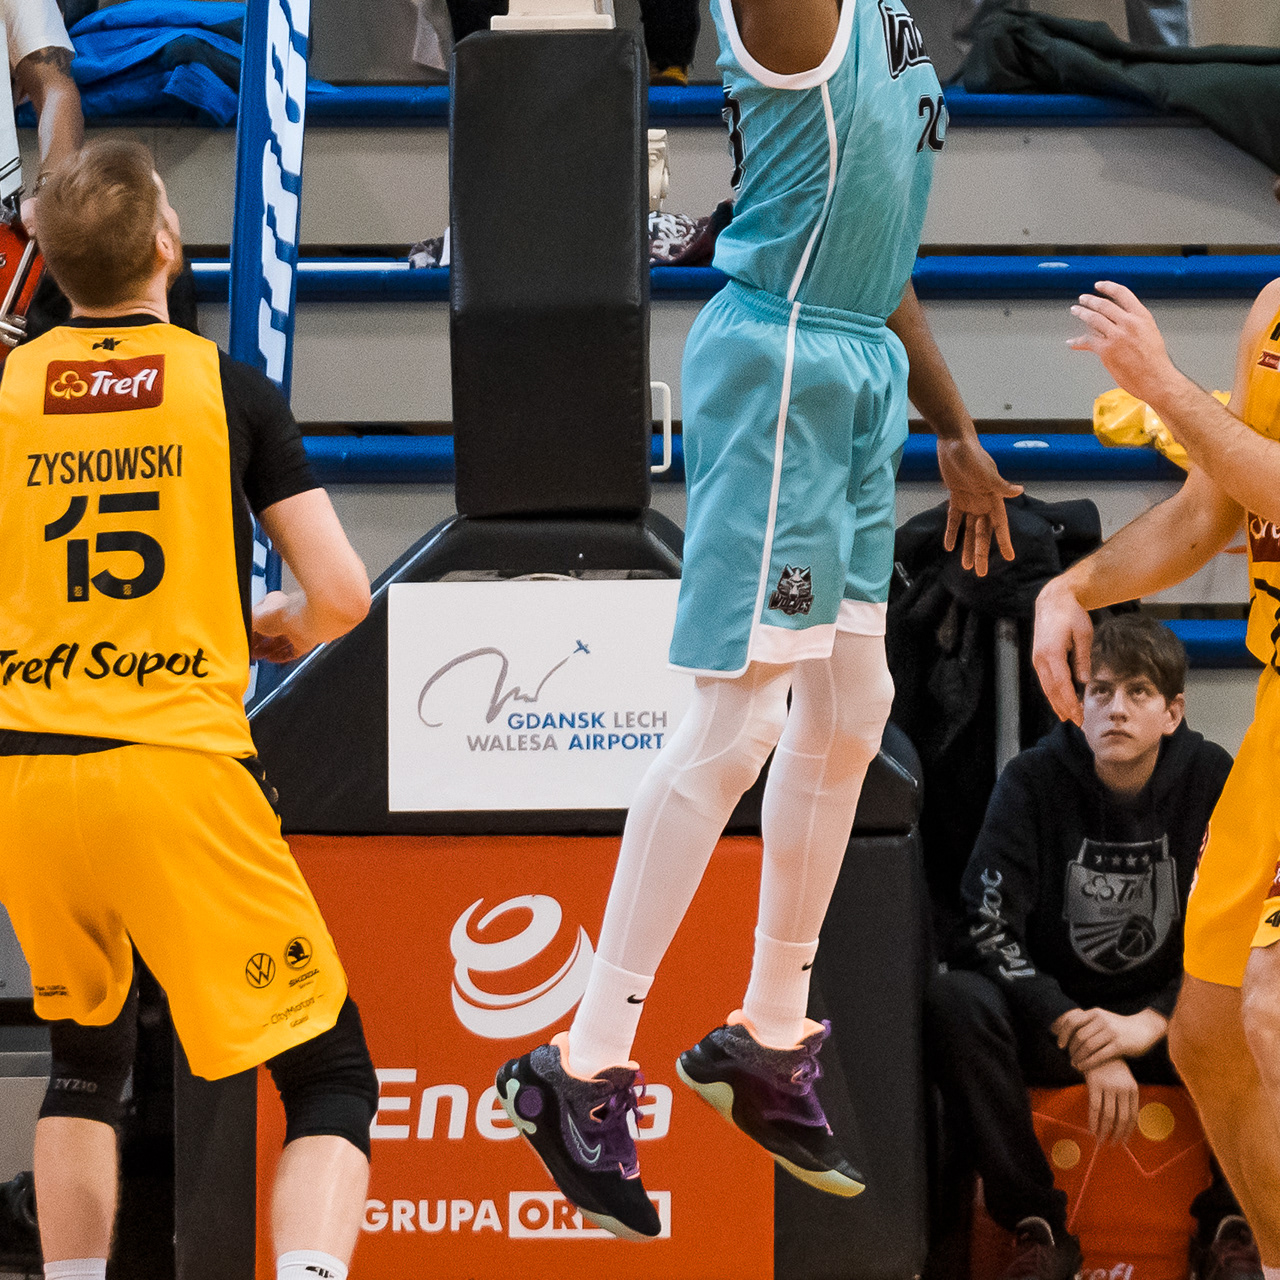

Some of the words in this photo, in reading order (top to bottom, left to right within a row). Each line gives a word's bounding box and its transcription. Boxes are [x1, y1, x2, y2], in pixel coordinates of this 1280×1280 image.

[88, 368, 160, 398] Trefl
[26, 444, 183, 487] ZYSKOWSKI
[44, 491, 166, 602] 15
[84, 641, 210, 687] Sopot
[507, 712, 606, 730] GDANSK
[613, 711, 667, 729] LECH
[467, 734, 559, 752] WALESA
[568, 733, 665, 751] AIRPORT
[370, 1067, 673, 1141] Enea
[363, 1198, 497, 1233] GRUPA
